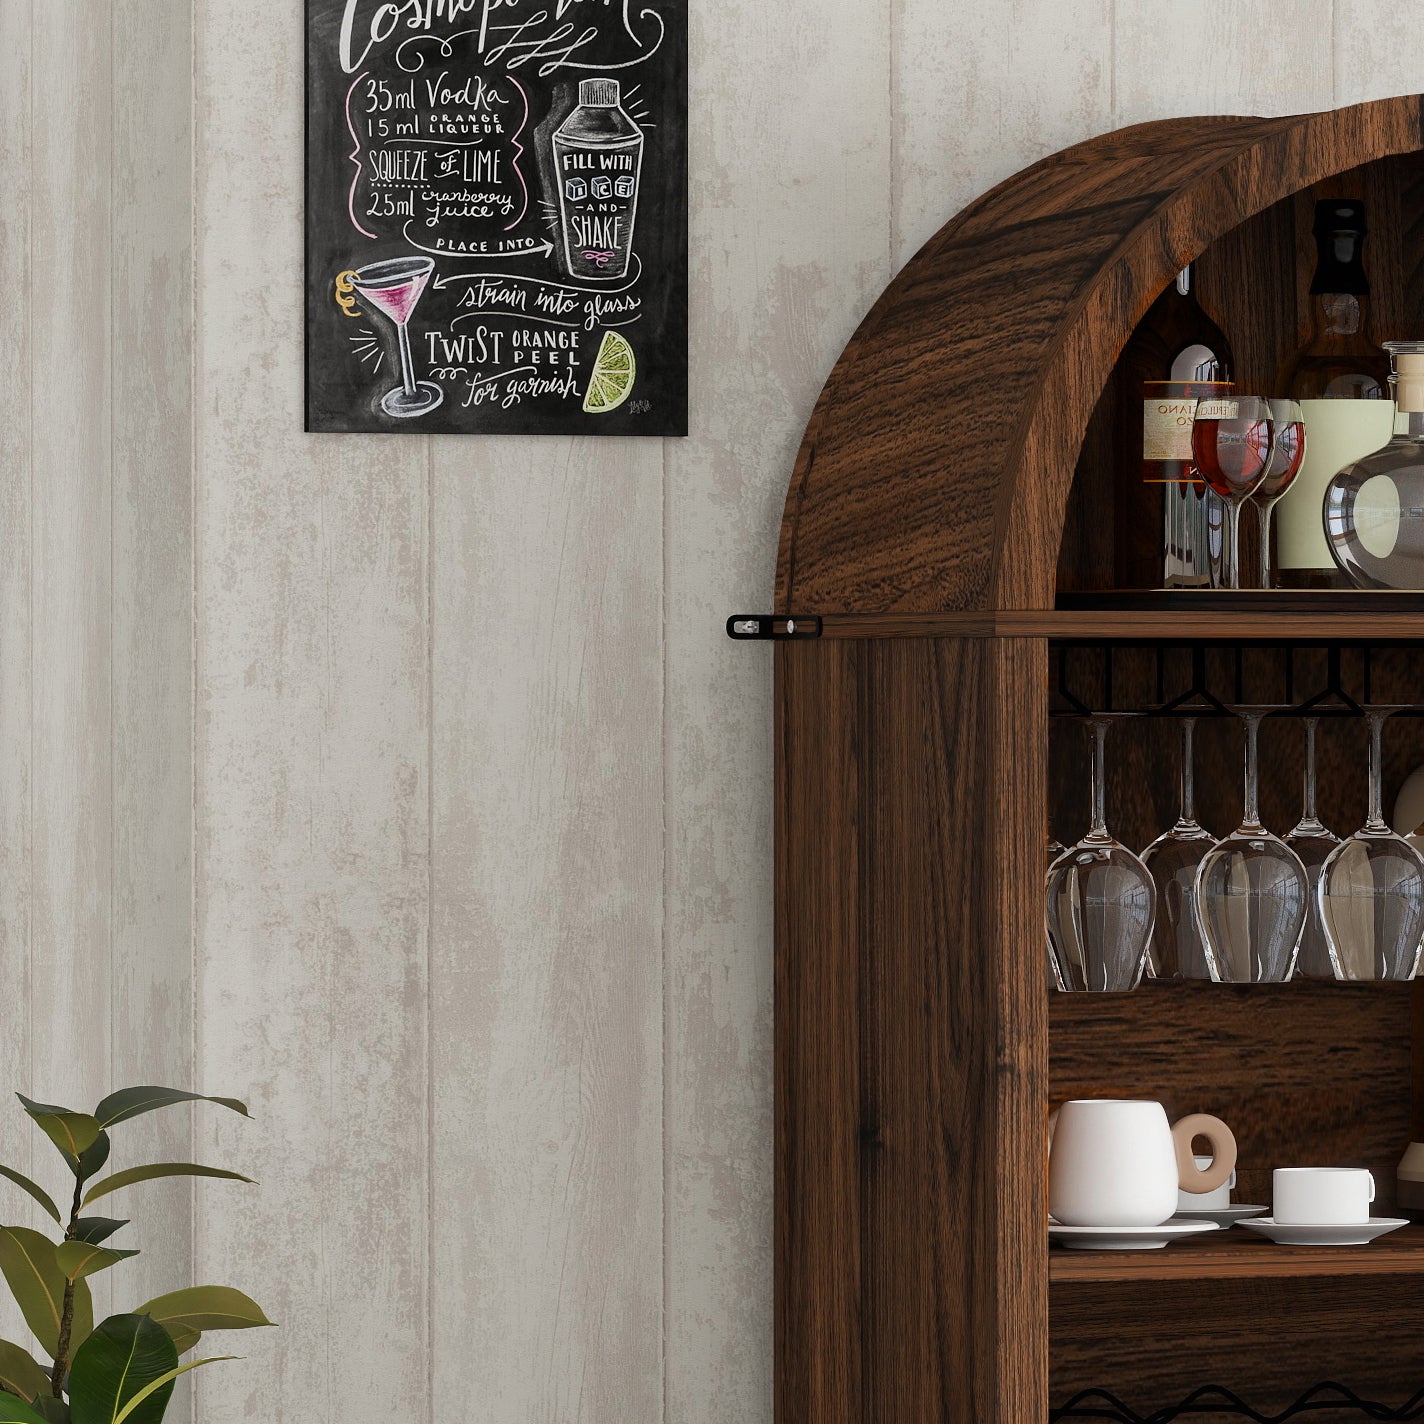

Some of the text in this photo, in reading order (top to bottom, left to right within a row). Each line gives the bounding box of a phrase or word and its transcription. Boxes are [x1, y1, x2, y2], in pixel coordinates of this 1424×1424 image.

[426, 71, 509, 111] Vodka
[430, 114, 500, 123] ORANGE
[430, 123, 504, 134] LIQUEUR
[369, 150, 502, 183] SQUEEZE of LIME
[563, 154, 633, 171] FILL WITH
[421, 188, 515, 215] cranberry
[426, 202, 494, 227] juice
[436, 237, 535, 251] PLACE INTO
[571, 216, 623, 249] SHAKE
[457, 278, 642, 331] strain into glass
[425, 325, 580, 365] TWIST ORANGE
[514, 351, 580, 365] PEEL
[461, 367, 581, 409] for garnish
